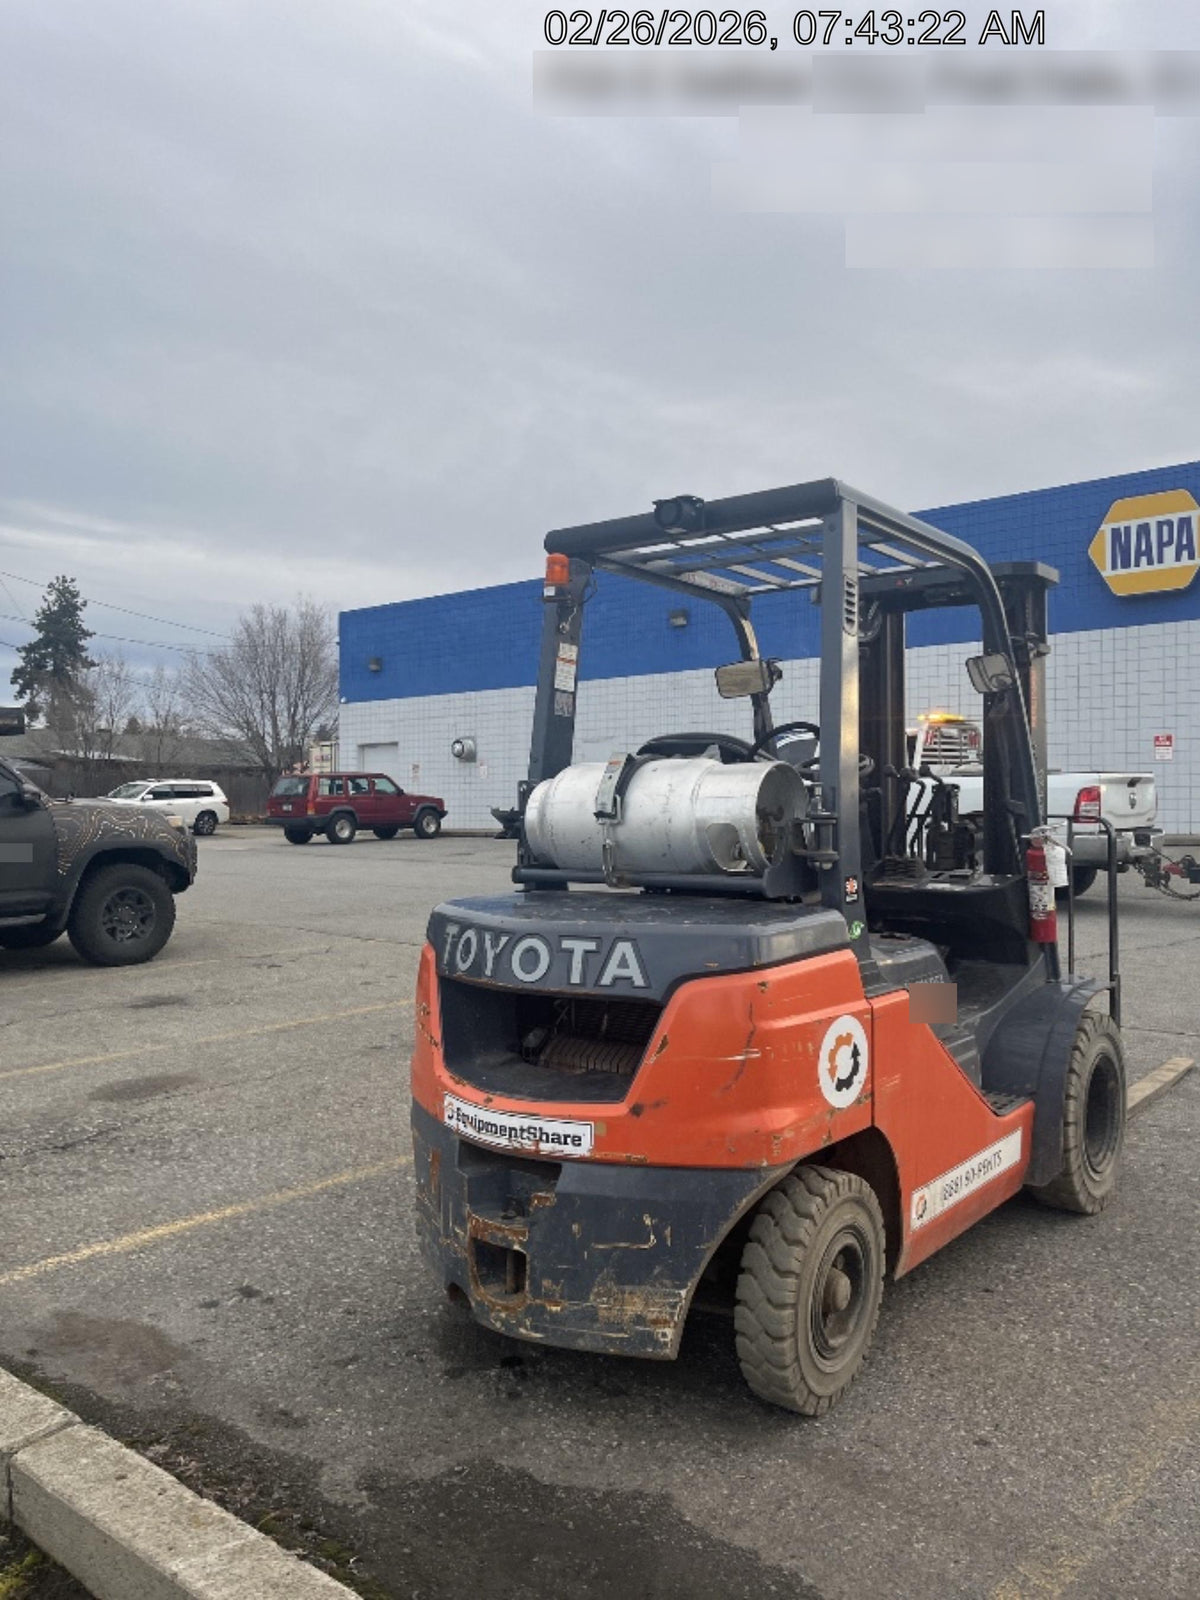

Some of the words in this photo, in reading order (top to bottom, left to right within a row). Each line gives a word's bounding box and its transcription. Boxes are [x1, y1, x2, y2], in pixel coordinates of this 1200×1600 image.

[1110, 515, 1196, 571] NAPA
[443, 922, 647, 988] TOYOTA
[455, 1106, 583, 1147] EquipmentShare
